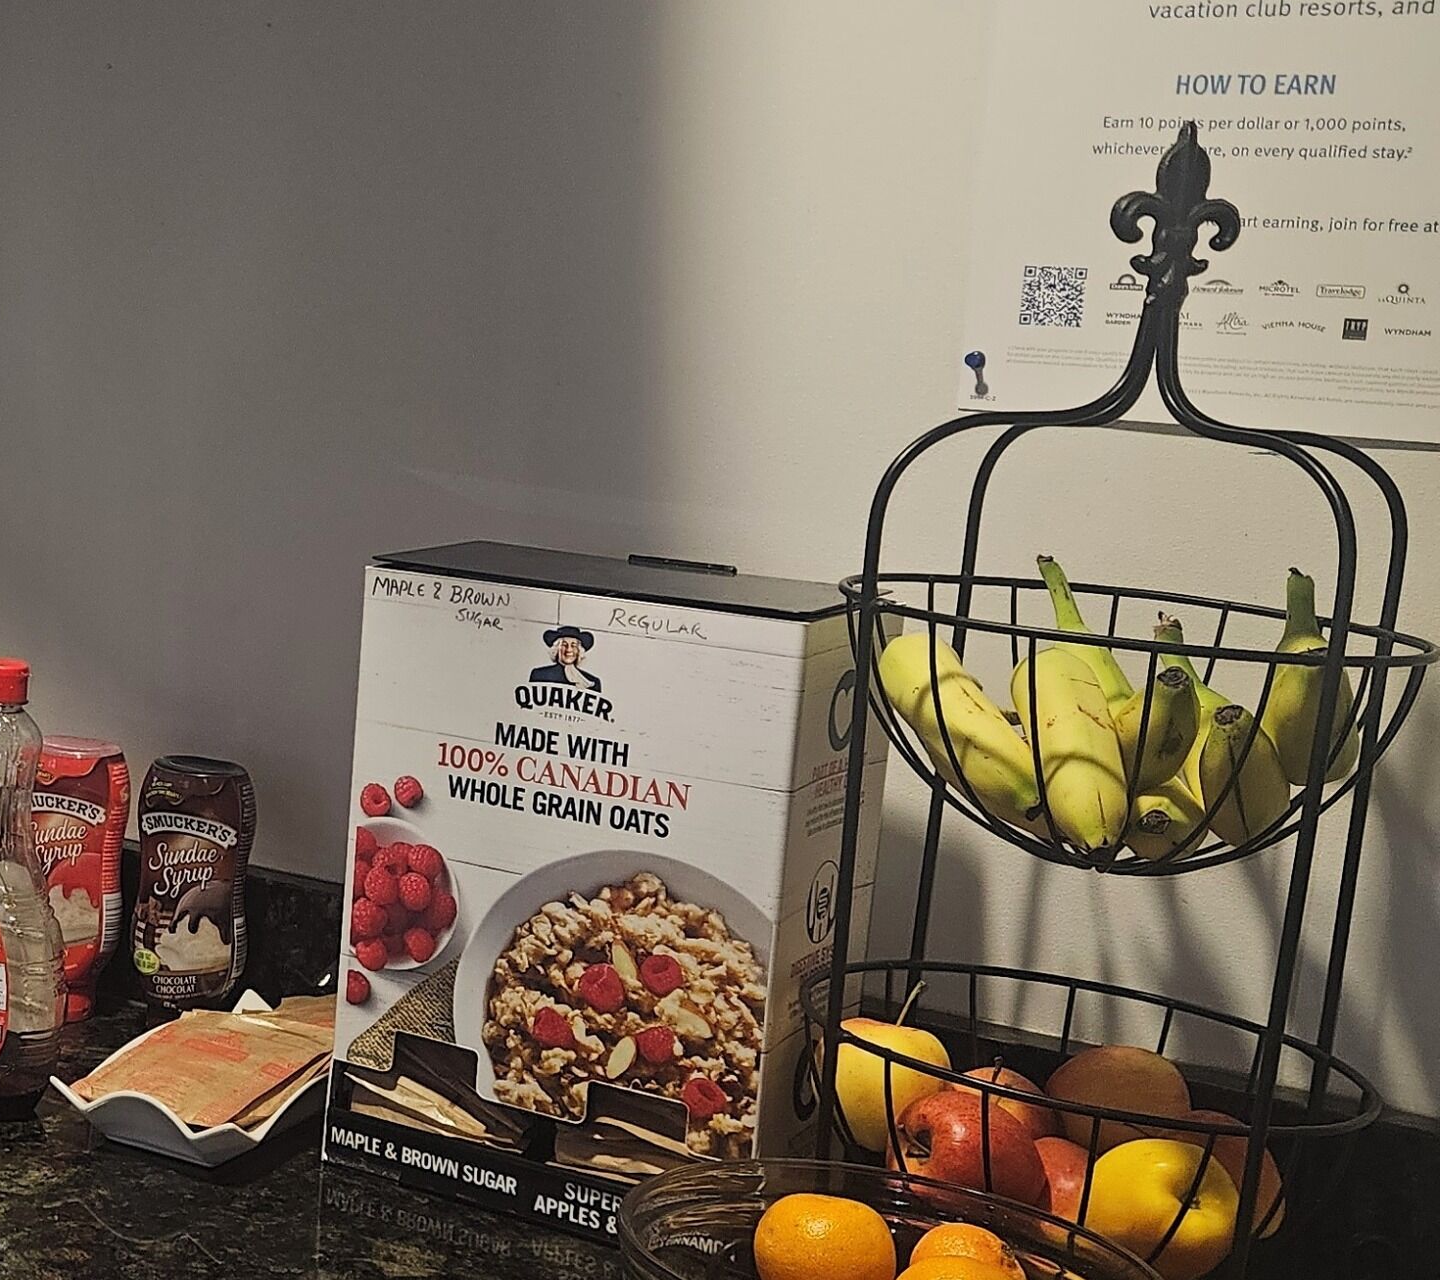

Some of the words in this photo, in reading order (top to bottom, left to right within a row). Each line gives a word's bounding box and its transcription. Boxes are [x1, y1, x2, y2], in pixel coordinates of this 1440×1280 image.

[1149, 0, 1238, 19] vacation
[1299, 0, 1383, 18] resorts,
[1175, 74, 1232, 96] HOW
[1237, 74, 1266, 96] TO
[1273, 74, 1337, 96] EARN
[1103, 116, 1134, 129] Earn
[1139, 117, 1154, 129] 10
[1158, 116, 1204, 133] pois
[1209, 120, 1233, 134] per
[1236, 116, 1282, 131] dollar
[1284, 120, 1300, 131] or
[1304, 117, 1347, 133] 1,000
[1351, 118, 1407, 134] points,
[1092, 142, 1165, 156] whichever
[1231, 146, 1250, 157] on
[1254, 147, 1295, 161] every
[1299, 144, 1369, 161] qualified
[1262, 217, 1324, 233] earning,
[1328, 217, 1357, 233] join
[1362, 218, 1386, 231] for
[1388, 219, 1419, 233] free
[1423, 220, 1440, 233] at
[1106, 311, 1142, 320] WYNDHA
[1384, 327, 1432, 337] WYNDHAM
[372, 575, 426, 598] MAPLE
[449, 584, 511, 608] BROWN
[455, 607, 504, 631] SUGAR
[609, 607, 708, 641] REGULAR
[494, 722, 560, 755] MADE
[567, 733, 629, 767] WITH
[437, 742, 509, 777] 100%
[516, 756, 692, 811] CANADIAN
[31, 794, 101, 820] UCKER'S
[448, 774, 526, 812] WHOLE
[532, 791, 602, 826] GRAIN
[609, 805, 670, 839] OATS
[145, 814, 232, 843] SMUCKER'S
[148, 841, 217, 870] Sundae
[153, 866, 213, 899] Syrup
[152, 975, 197, 985] CHOCOLATE
[155, 984, 196, 994] CHOCOLAT
[331, 1126, 382, 1157] MAPLE
[384, 1141, 398, 1161] &
[401, 1147, 459, 1179] BROWN
[462, 1164, 518, 1196] SUGAR
[534, 1194, 601, 1231] APPLES
[605, 1216, 618, 1235] &
